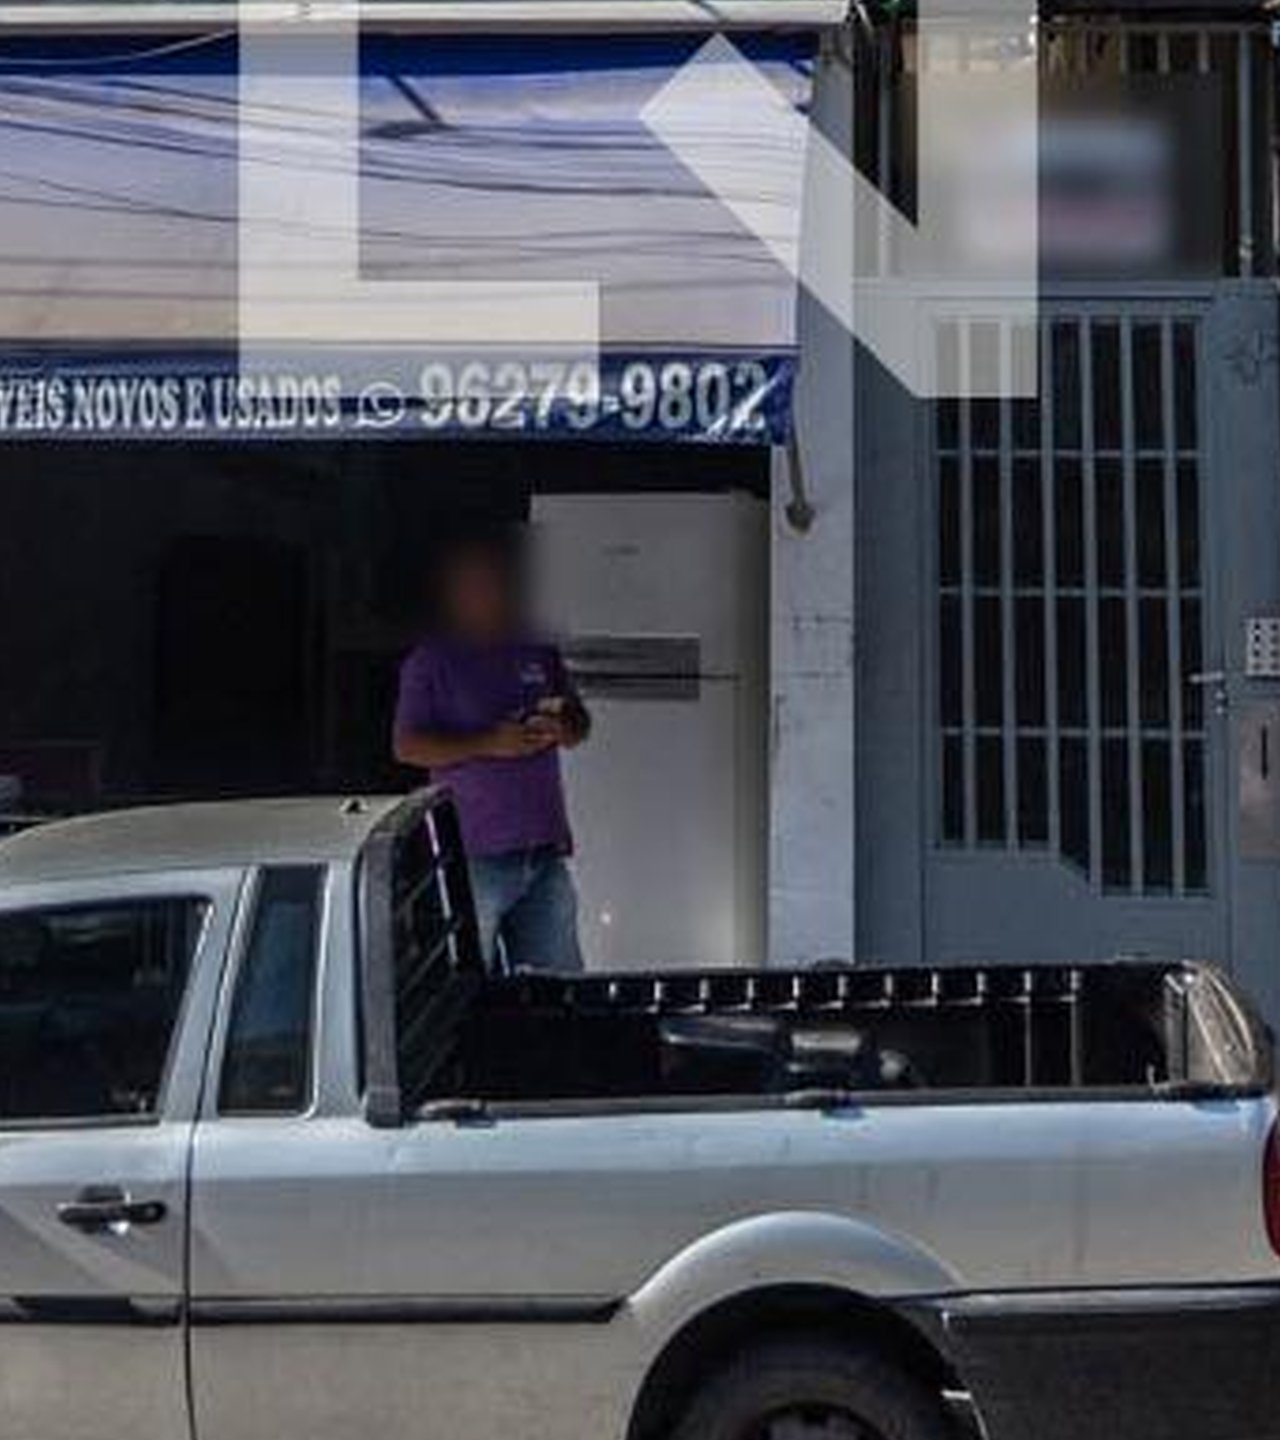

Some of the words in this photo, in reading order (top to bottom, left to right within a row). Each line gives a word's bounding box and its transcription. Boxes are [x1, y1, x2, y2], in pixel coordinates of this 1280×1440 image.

[72, 374, 179, 430] NOVOS
[185, 377, 206, 428] E
[214, 374, 341, 428] USADOS
[419, 360, 768, 431] 96279-9802
